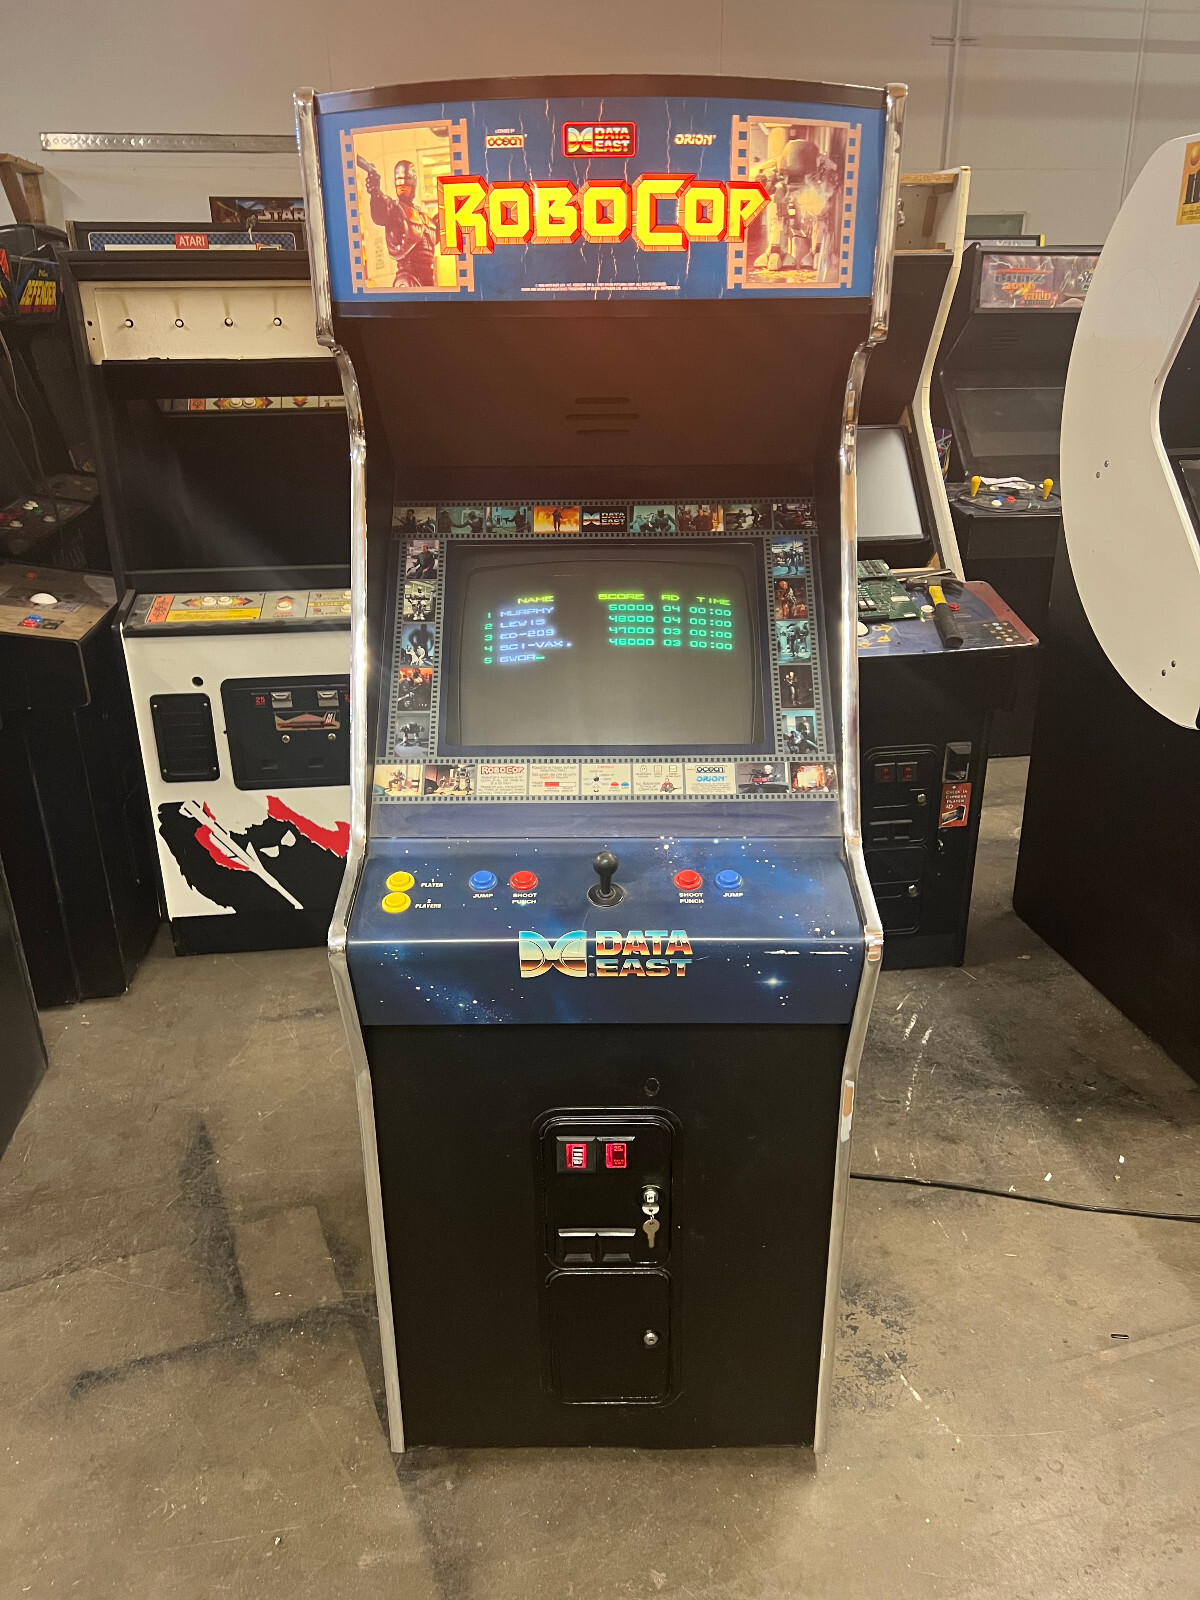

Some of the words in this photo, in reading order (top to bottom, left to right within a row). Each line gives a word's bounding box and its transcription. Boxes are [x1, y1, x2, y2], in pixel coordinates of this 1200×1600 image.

[594, 127, 631, 139] DATA
[594, 140, 630, 153] EAST
[179, 235, 205, 246] ATARI
[601, 518, 626, 526] EAST
[517, 595, 555, 605] NAME
[598, 593, 645, 601] SCORE
[696, 596, 731, 606] TIME
[500, 606, 555, 618] MURPHY
[608, 604, 655, 612] 50000
[662, 605, 681, 613] 04
[689, 606, 732, 617] 00:00
[484, 623, 494, 631] 2
[500, 619, 546, 629] LEWIS
[662, 616, 681, 624] 04
[689, 617, 732, 628] 00:00
[484, 634, 494, 642] 3
[500, 629, 555, 640] ED-209
[608, 627, 655, 635] 47000
[663, 628, 682, 636] 03
[689, 629, 732, 639] 00:00
[484, 645, 493, 653] 4
[663, 639, 682, 647] 03
[689, 640, 733, 651] 00:00
[483, 656, 493, 665] 5
[255, 696, 266, 704] 25
[595, 930, 694, 956] DATA
[595, 958, 693, 978] EAST
